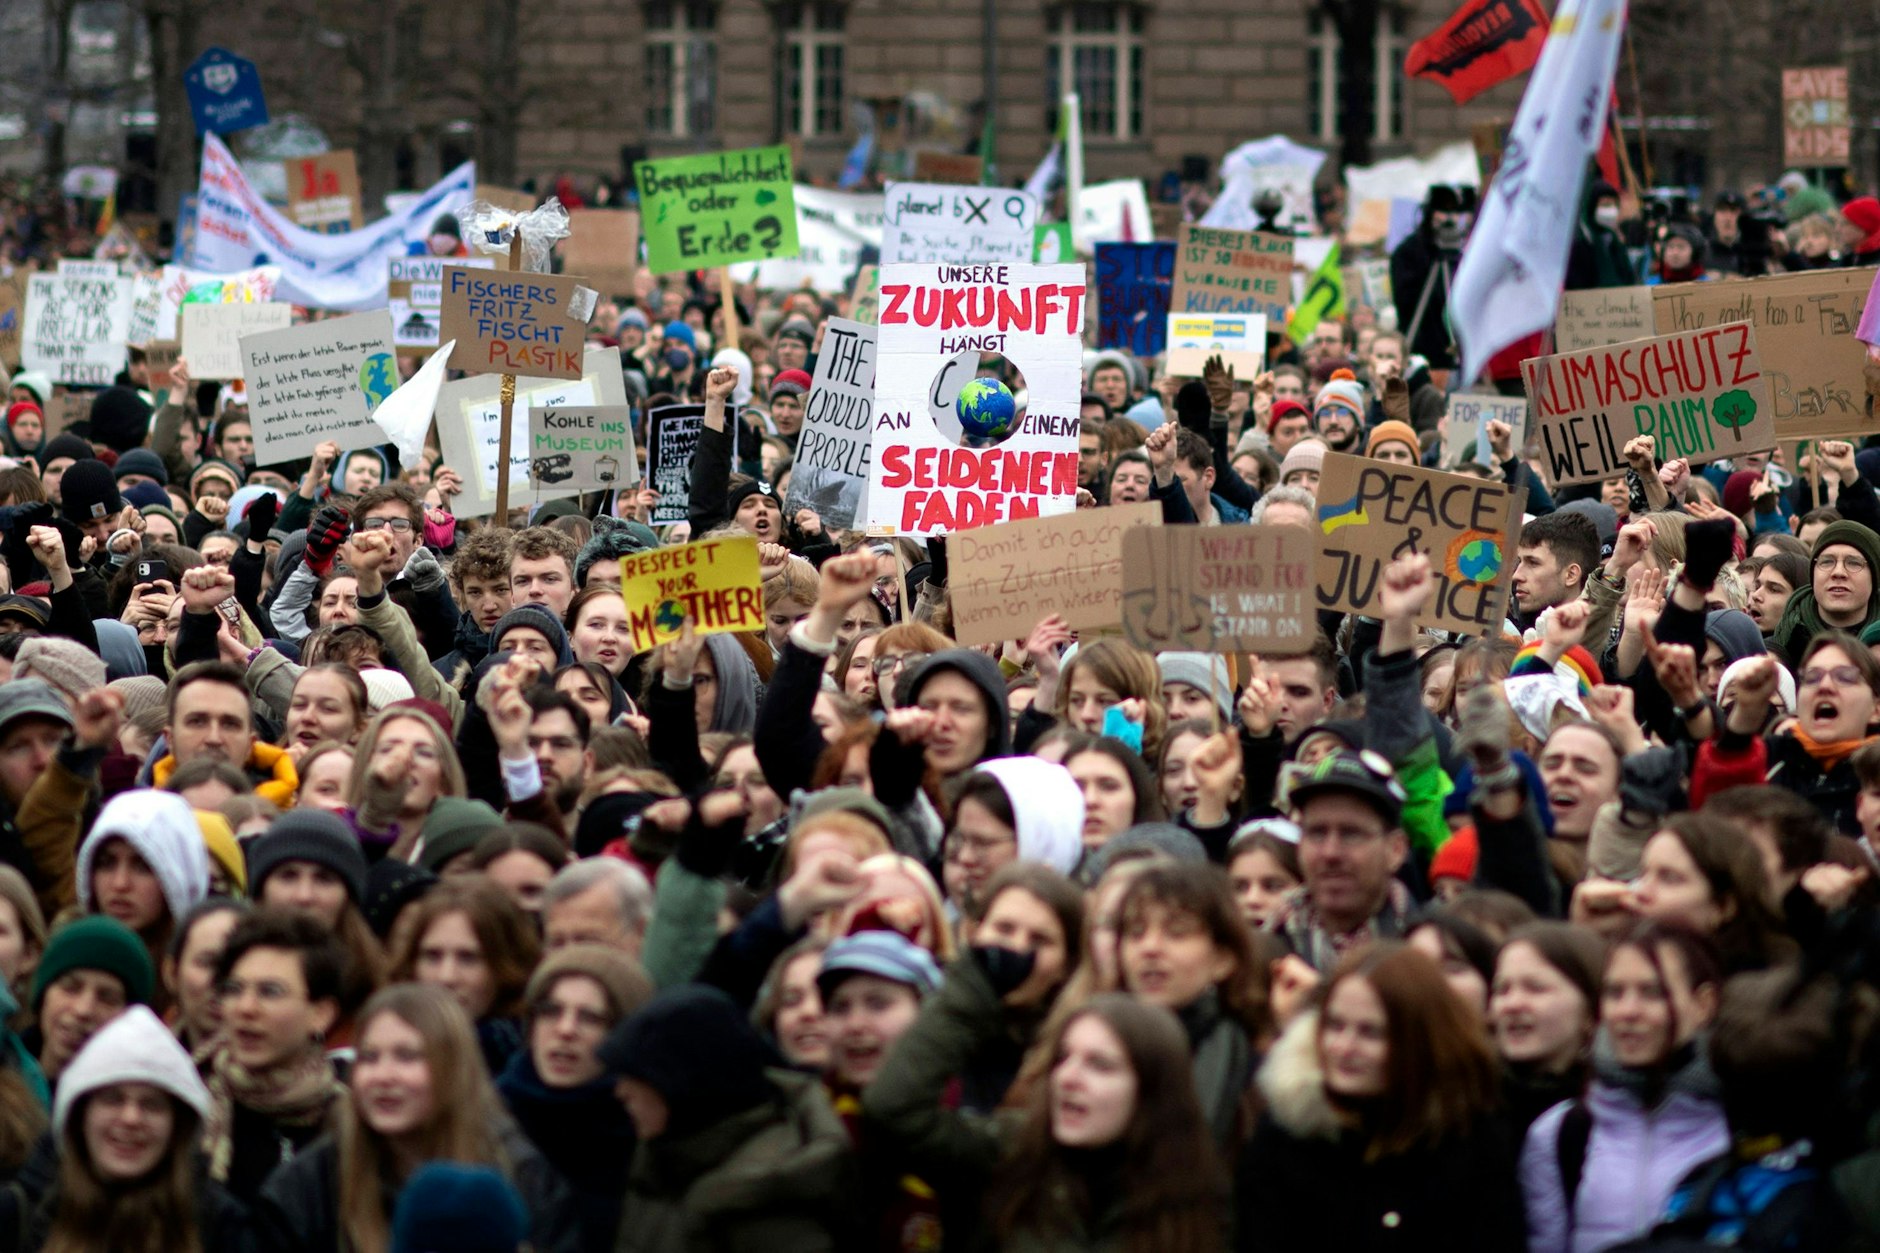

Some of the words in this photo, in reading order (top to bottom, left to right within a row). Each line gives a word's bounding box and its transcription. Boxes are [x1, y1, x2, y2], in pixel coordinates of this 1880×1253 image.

[688, 187, 739, 213] oder
[896, 192, 943, 226] planet
[938, 266, 1009, 285] UNSERE
[1100, 246, 1174, 281] STO
[451, 272, 557, 305] FISCHERS
[468, 299, 537, 321] FRITZ
[880, 283, 1086, 335] ZUKUNFT
[1653, 292, 1705, 330] The
[1766, 296, 1788, 326] has
[1794, 303, 1806, 323] a
[477, 319, 565, 344] FISCHT
[940, 334, 1007, 354] HÄNGT
[251, 352, 270, 367] Erst
[489, 340, 582, 374] PLASTIK
[827, 328, 874, 387] THE
[1528, 324, 1760, 417] KLIMASCHUTZ
[256, 376, 271, 390] der
[257, 396, 271, 408] der
[807, 387, 871, 430] WOULD
[1454, 402, 1480, 422] FOR
[1490, 404, 1522, 425] THE
[305, 424, 323, 435] Gold
[544, 411, 595, 429] KOHLE
[601, 422, 626, 434] INS
[876, 411, 911, 430] AN
[1023, 414, 1080, 437] EINEM
[535, 433, 624, 451] MUSEUM
[796, 428, 872, 478] PROBLE
[1542, 412, 1631, 482] WEIL
[1633, 397, 1715, 461] BAUM
[881, 445, 1079, 495] SEIDENEN
[901, 490, 1040, 532] FADEN
[1355, 468, 1505, 534] PEACE
[961, 534, 1025, 562] Damit
[1037, 528, 1065, 548] ich
[1070, 517, 1121, 545] auch
[1200, 536, 1259, 560] WHAT
[1276, 536, 1284, 560] I
[625, 542, 720, 579] RESPECT
[967, 573, 989, 596] in
[1000, 552, 1085, 594] Zukunft
[657, 572, 698, 597] YOUR
[1200, 563, 1263, 588] STAND
[1273, 563, 1308, 588] FOR
[1316, 548, 1504, 626] JUICE
[1210, 592, 1228, 614] IS
[1238, 593, 1285, 613] WHAT
[1213, 616, 1268, 637] STAND
[1276, 616, 1301, 636] ON
